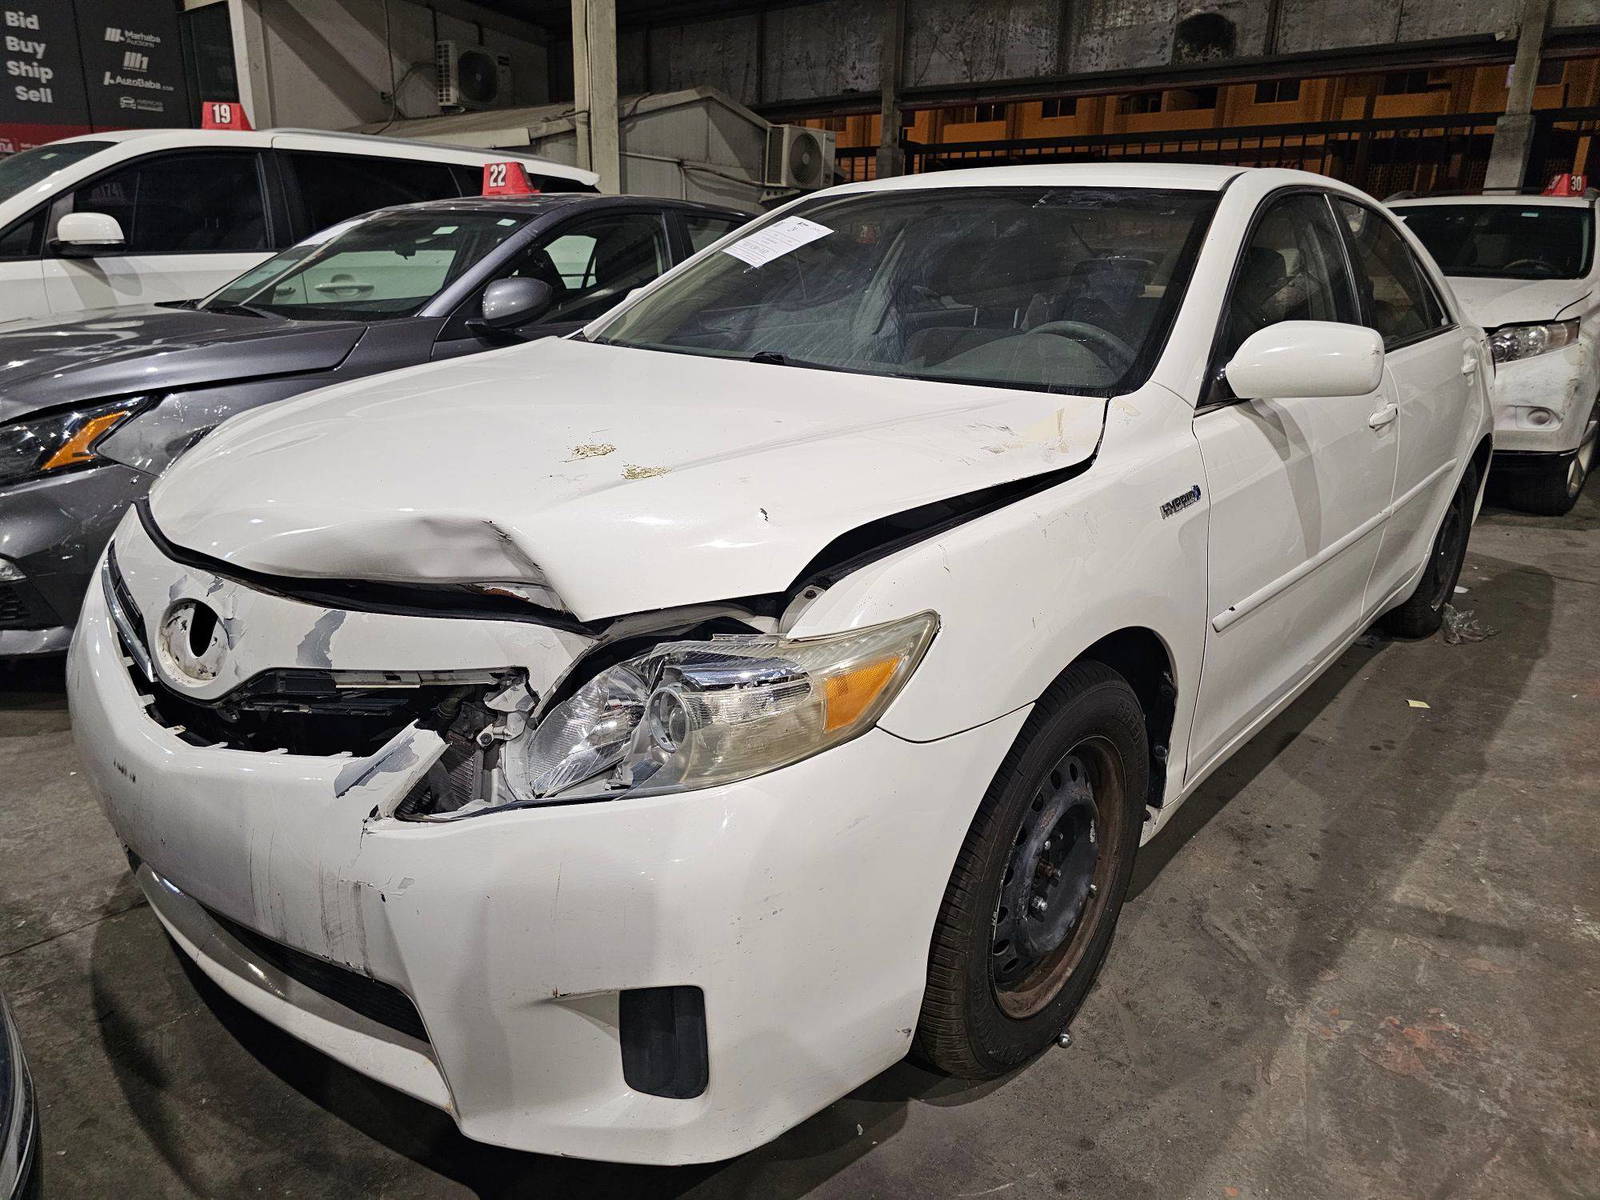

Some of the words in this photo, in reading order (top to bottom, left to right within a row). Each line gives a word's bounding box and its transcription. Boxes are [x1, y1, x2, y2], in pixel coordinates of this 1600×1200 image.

[5, 11, 40, 30] Bid
[5, 36, 46, 59] Buy
[6, 61, 54, 84] Ship
[15, 85, 53, 103] Sell
[212, 104, 231, 124] 19
[489, 163, 507, 188] 22
[1570, 175, 1583, 192] 30
